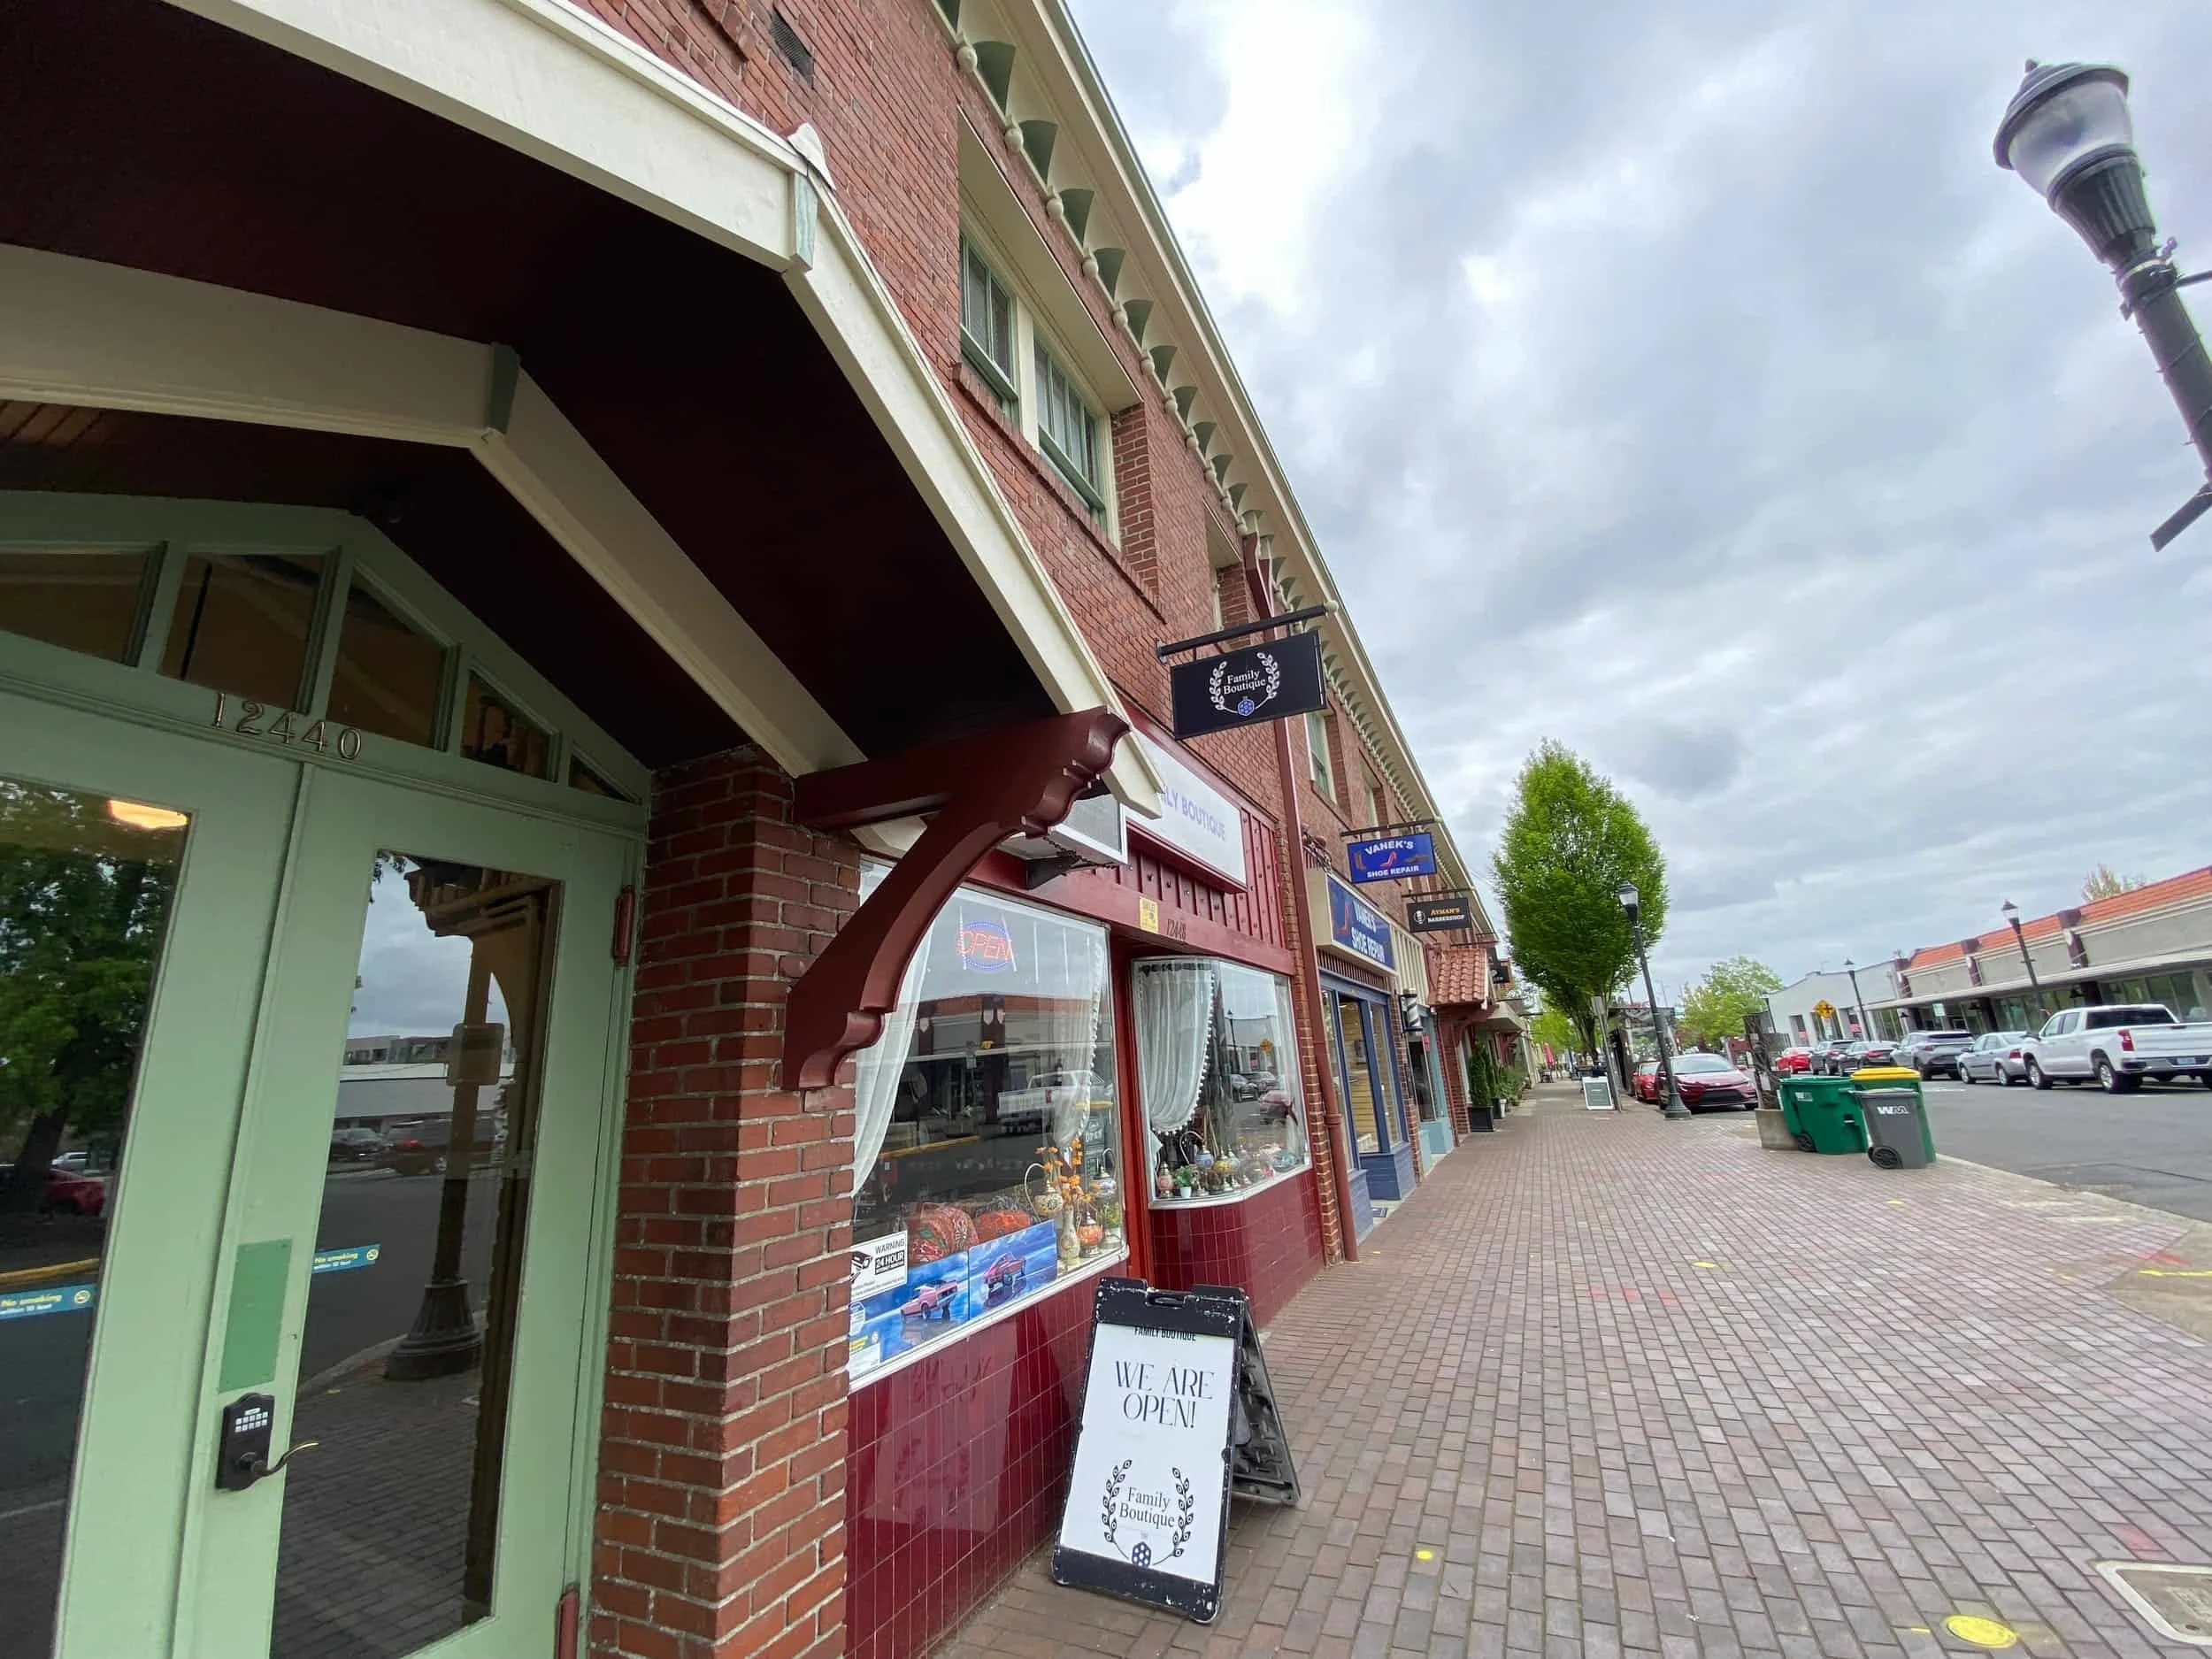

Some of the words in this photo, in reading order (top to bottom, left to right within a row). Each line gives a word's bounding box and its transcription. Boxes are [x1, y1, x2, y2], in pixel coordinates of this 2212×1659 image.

[1227, 670, 1260, 684] Family
[1223, 679, 1266, 695] Boutique
[212, 693, 361, 760] 12440
[1181, 796, 1225, 841] BOUTIQUE
[1364, 840, 1415, 855] VANEK'S
[1367, 869, 1388, 878] SHOE
[1390, 865, 1419, 875] REPAIR
[1353, 900, 1377, 933] VANEK'S
[1427, 914, 1465, 923] BARBERSHOP
[956, 931, 1012, 963] OPEN
[1351, 926, 1368, 955] SHOE
[1367, 936, 1386, 964] REPAIR
[875, 1239, 904, 1254] WARNING
[327, 1252, 358, 1262] smoking
[876, 1257, 885, 1268] 24
[885, 1252, 903, 1265] HOUR
[19, 1294, 63, 1305] smoking
[1134, 1326, 1159, 1338] FAMILY
[1161, 1329, 1196, 1341] BOUTIQUE
[1116, 1360, 1154, 1392] WE
[1163, 1367, 1215, 1400] ARE
[1123, 1393, 1196, 1428] OPEN!
[1128, 1486, 1171, 1513] Family
[1119, 1502, 1175, 1529] Boutique
